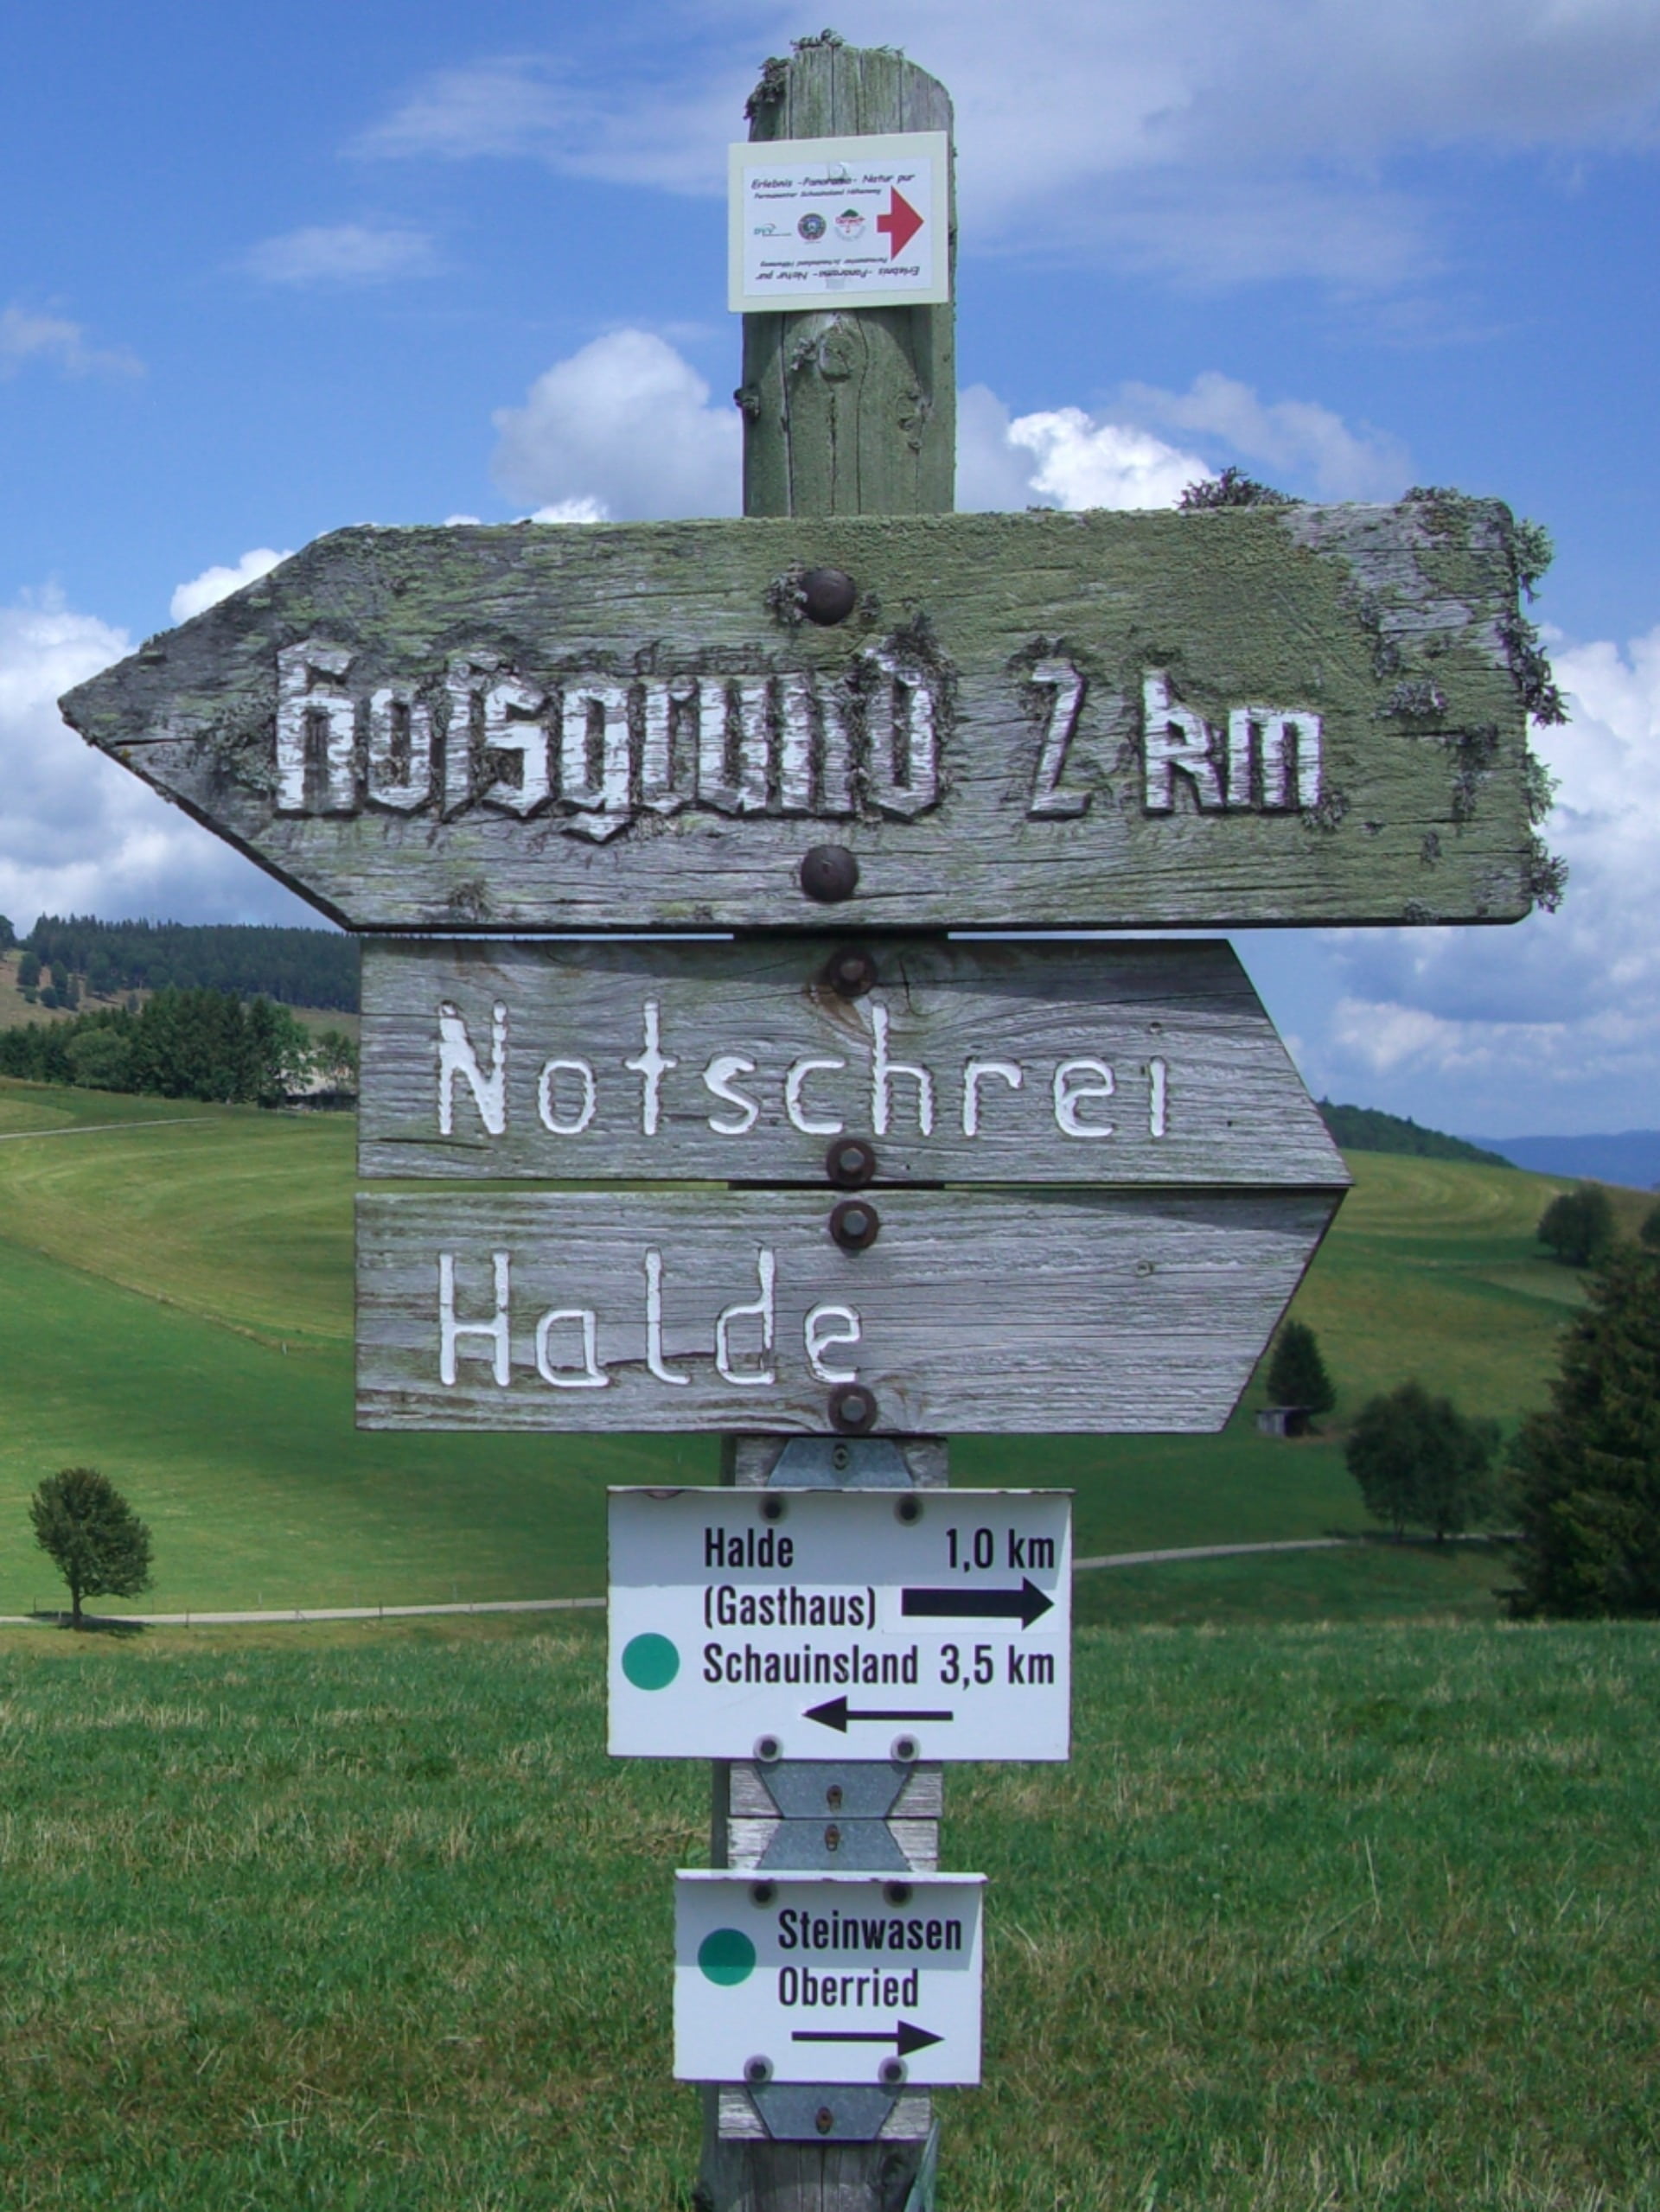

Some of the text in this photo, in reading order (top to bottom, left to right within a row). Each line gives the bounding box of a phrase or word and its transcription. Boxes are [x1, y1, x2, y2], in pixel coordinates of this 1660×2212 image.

[751, 178, 793, 189] Erlebnis
[862, 174, 894, 184] Natur
[897, 174, 916, 184] pur
[437, 998, 1167, 1138] Notschrei
[437, 1245, 861, 1387] Halde
[704, 1527, 1055, 1573] Halde 1,0 km
[704, 1585, 876, 1629] (Gasthaus)
[703, 1642, 1055, 1691] Schauinsland 3,5 km
[778, 1909, 962, 1951] Steinwasen
[778, 1966, 919, 2007] Oberried
